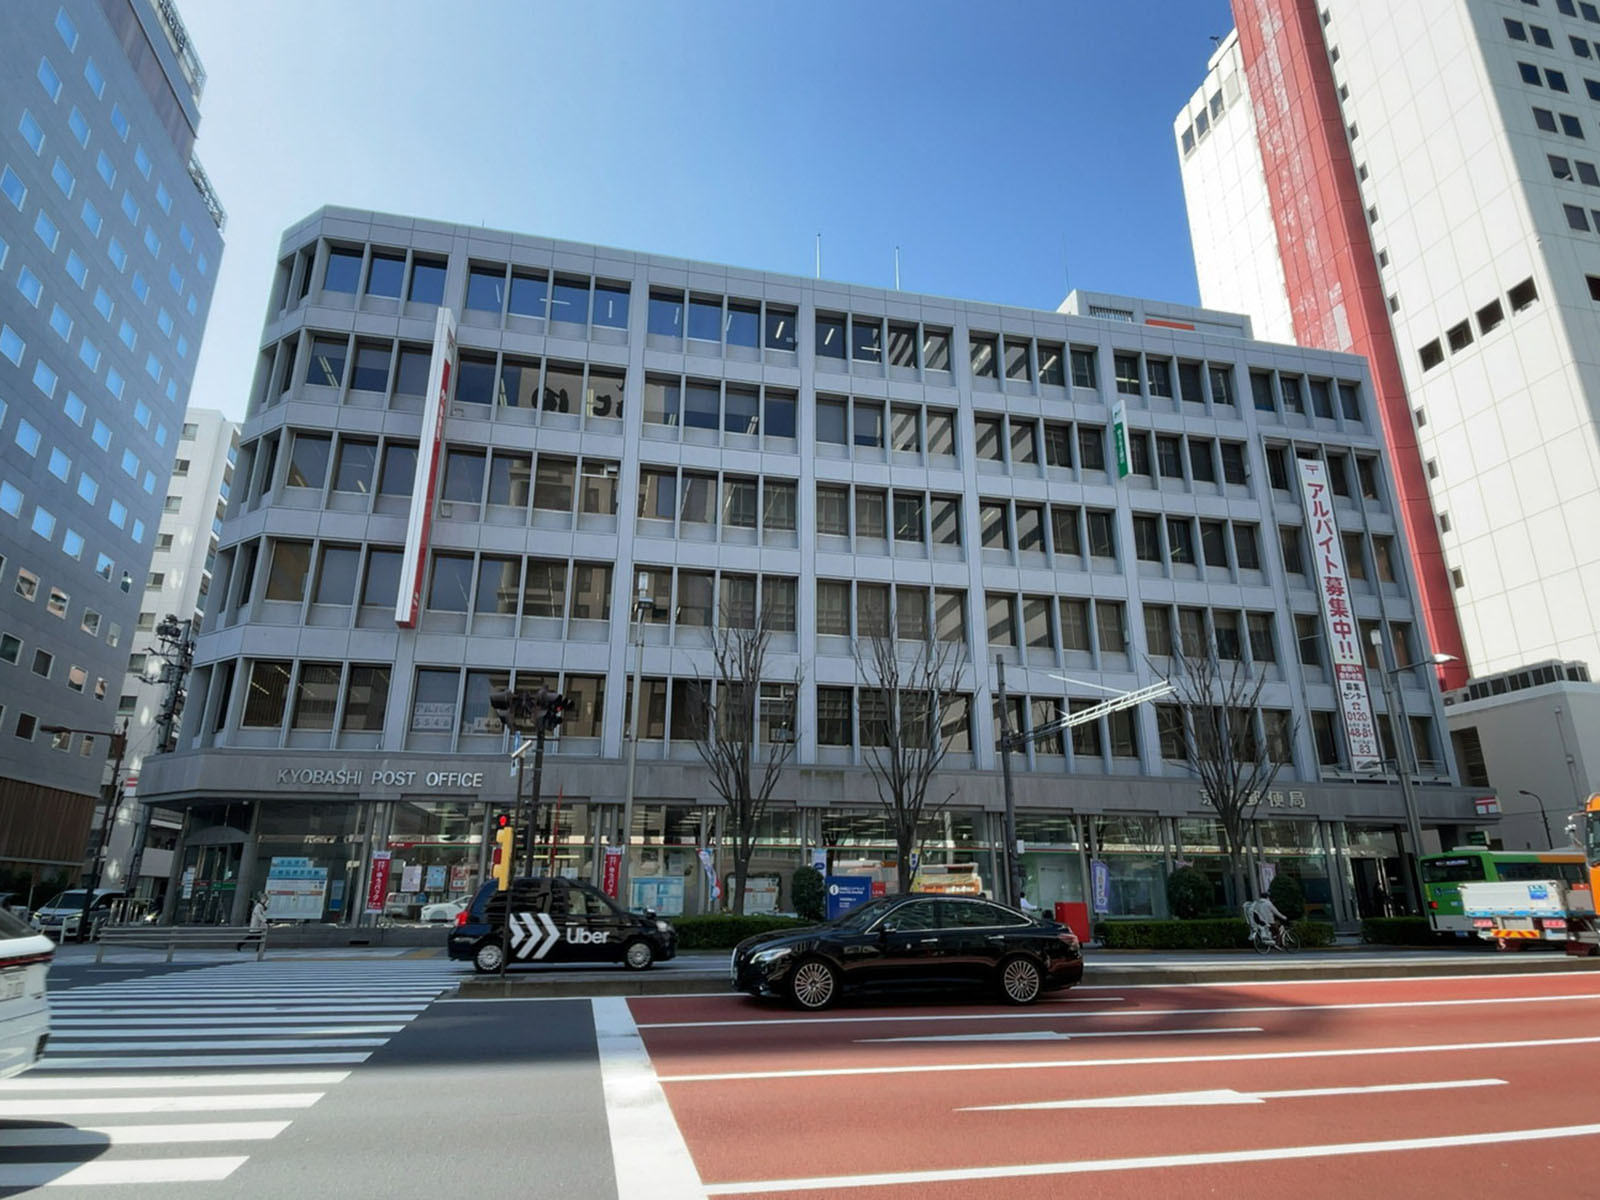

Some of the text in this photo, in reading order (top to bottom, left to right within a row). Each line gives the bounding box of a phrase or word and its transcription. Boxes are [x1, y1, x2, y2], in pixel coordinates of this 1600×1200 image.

[276, 768, 483, 788] KYOBASHI POST OFFICE
[566, 927, 610, 944] Uber
